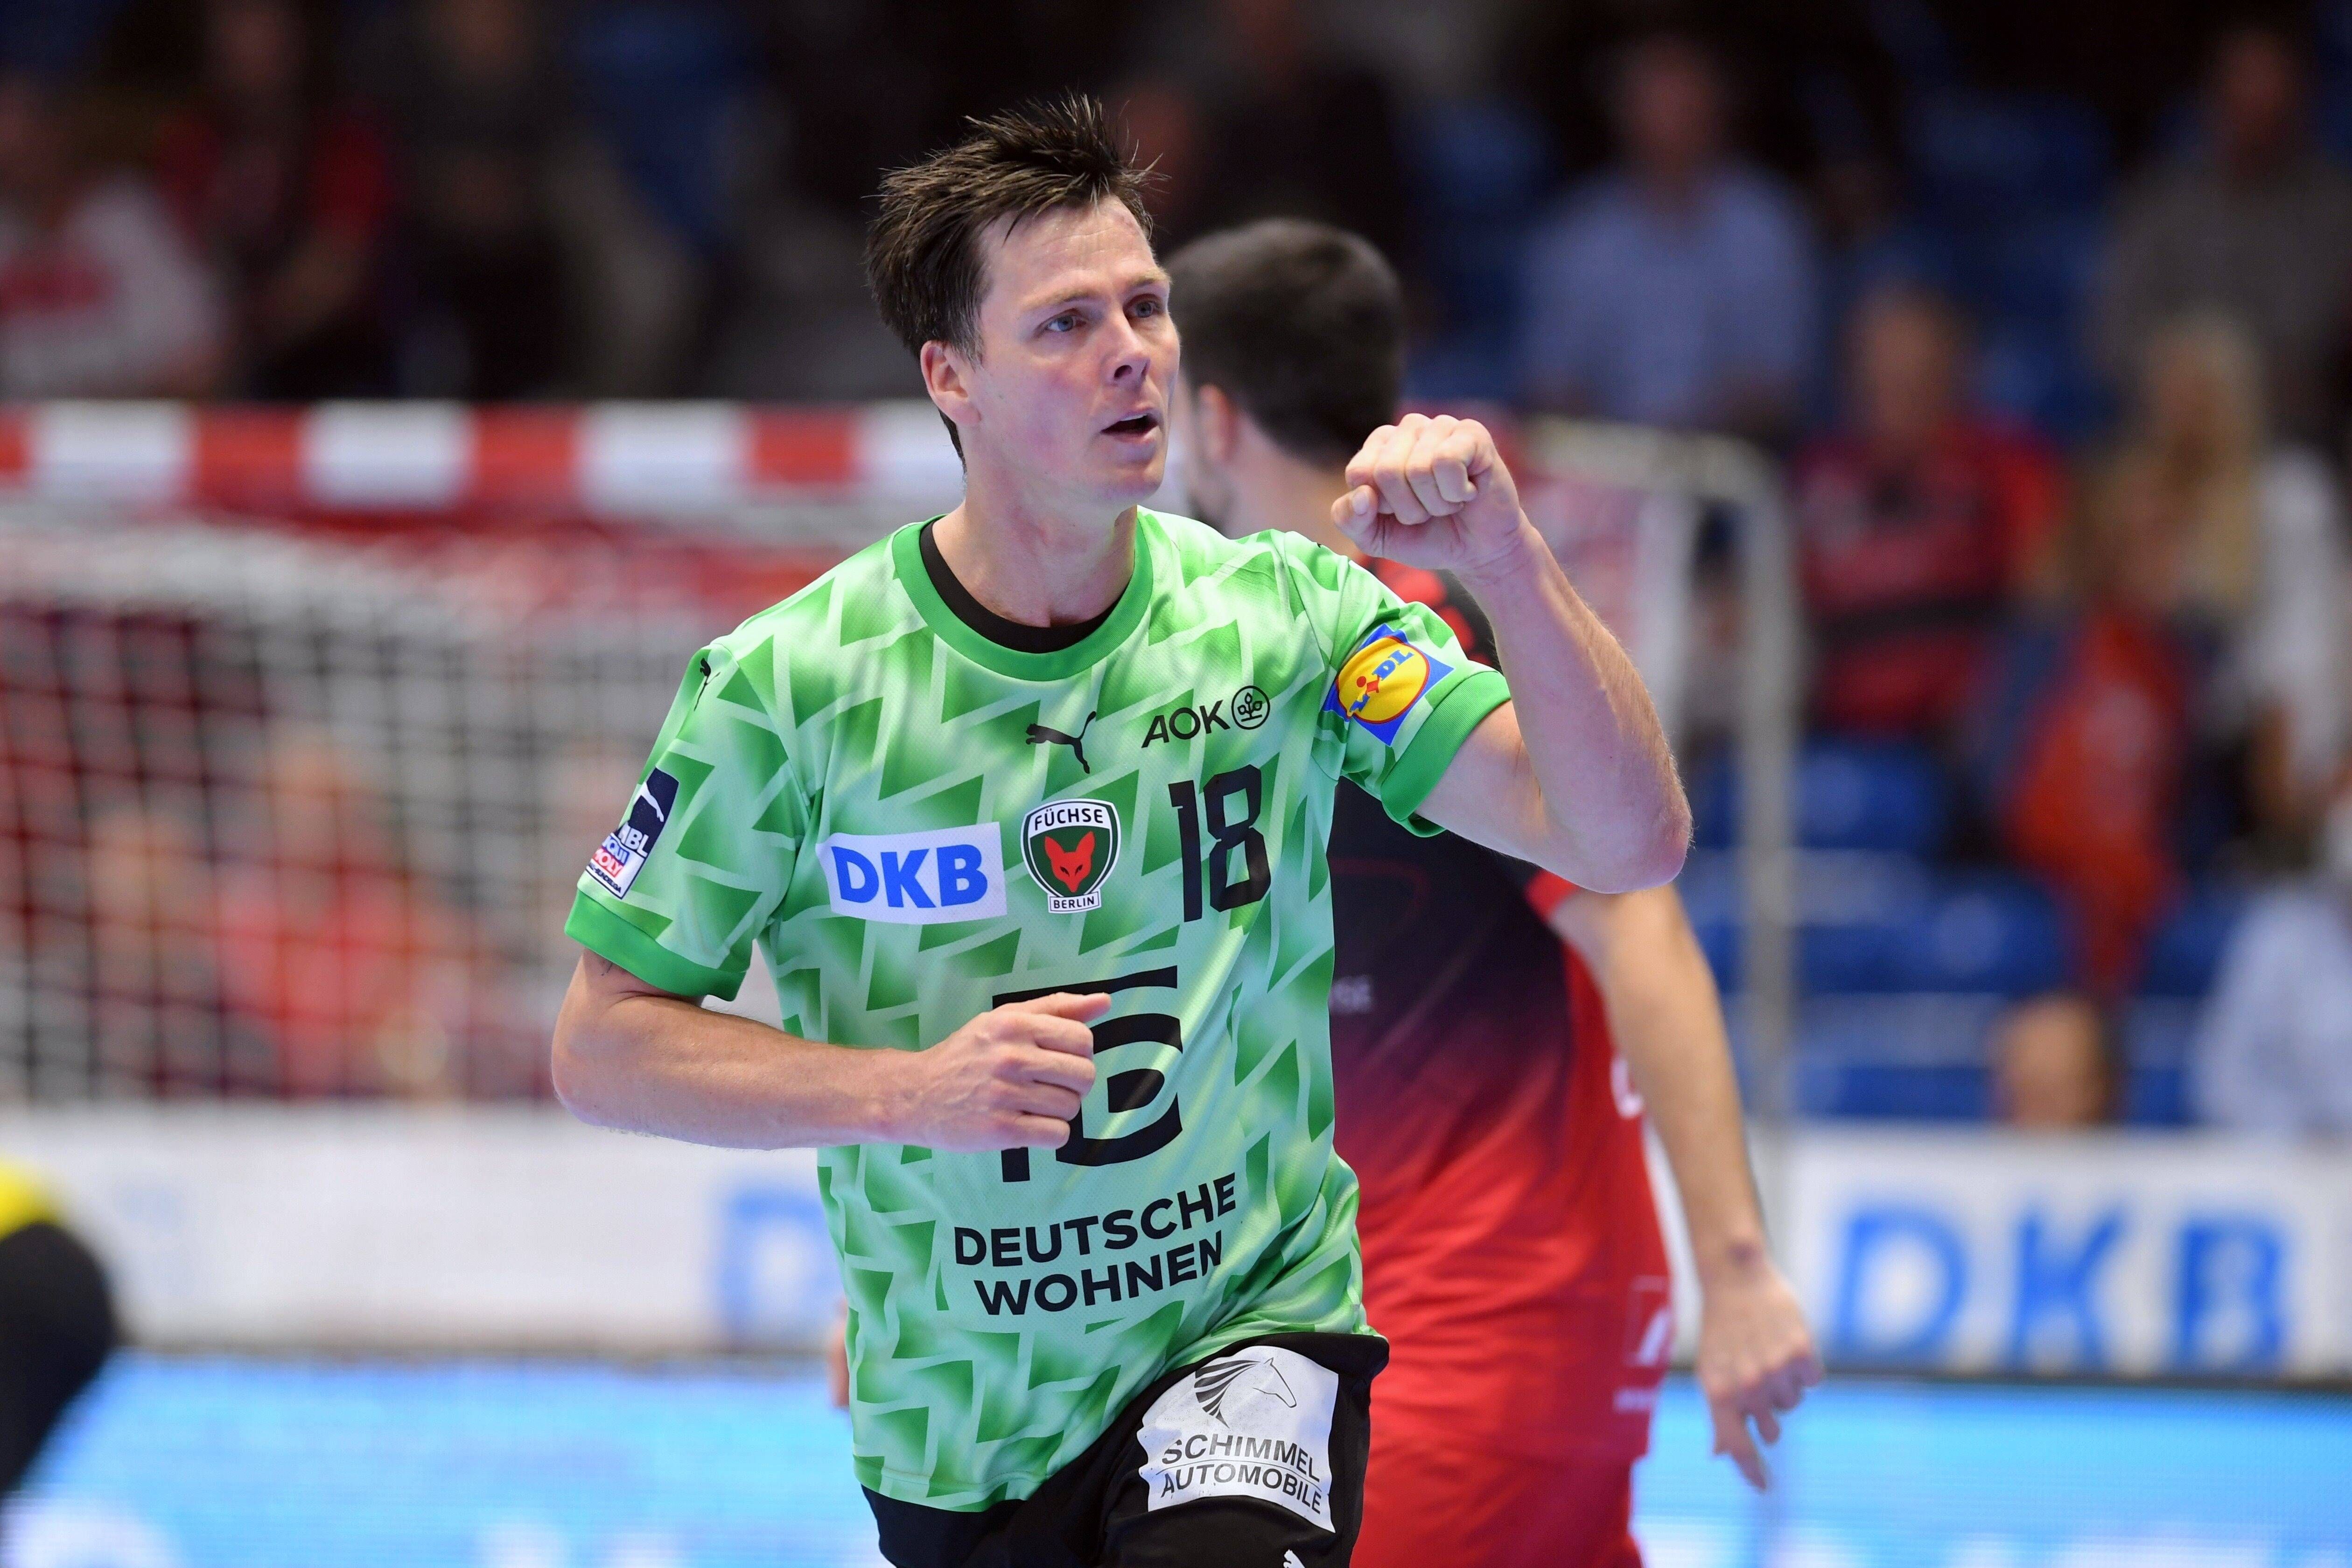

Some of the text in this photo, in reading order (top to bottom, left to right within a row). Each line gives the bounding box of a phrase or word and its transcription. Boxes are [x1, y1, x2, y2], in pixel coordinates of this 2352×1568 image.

[1141, 700, 1230, 748] AOK
[1034, 808, 1104, 831] FÜCHSE
[1168, 764, 1271, 923] 18
[831, 844, 988, 909] DKB
[1053, 896, 1095, 910] BERLIN
[954, 1172, 1236, 1267] DEUTSCHE
[974, 1230, 1222, 1316] WOHNEN
[1832, 1204, 2289, 1367] DKB
[1162, 1434, 1321, 1483] SCHIMMEL
[1161, 1463, 1322, 1514] AUTOMOBILE
